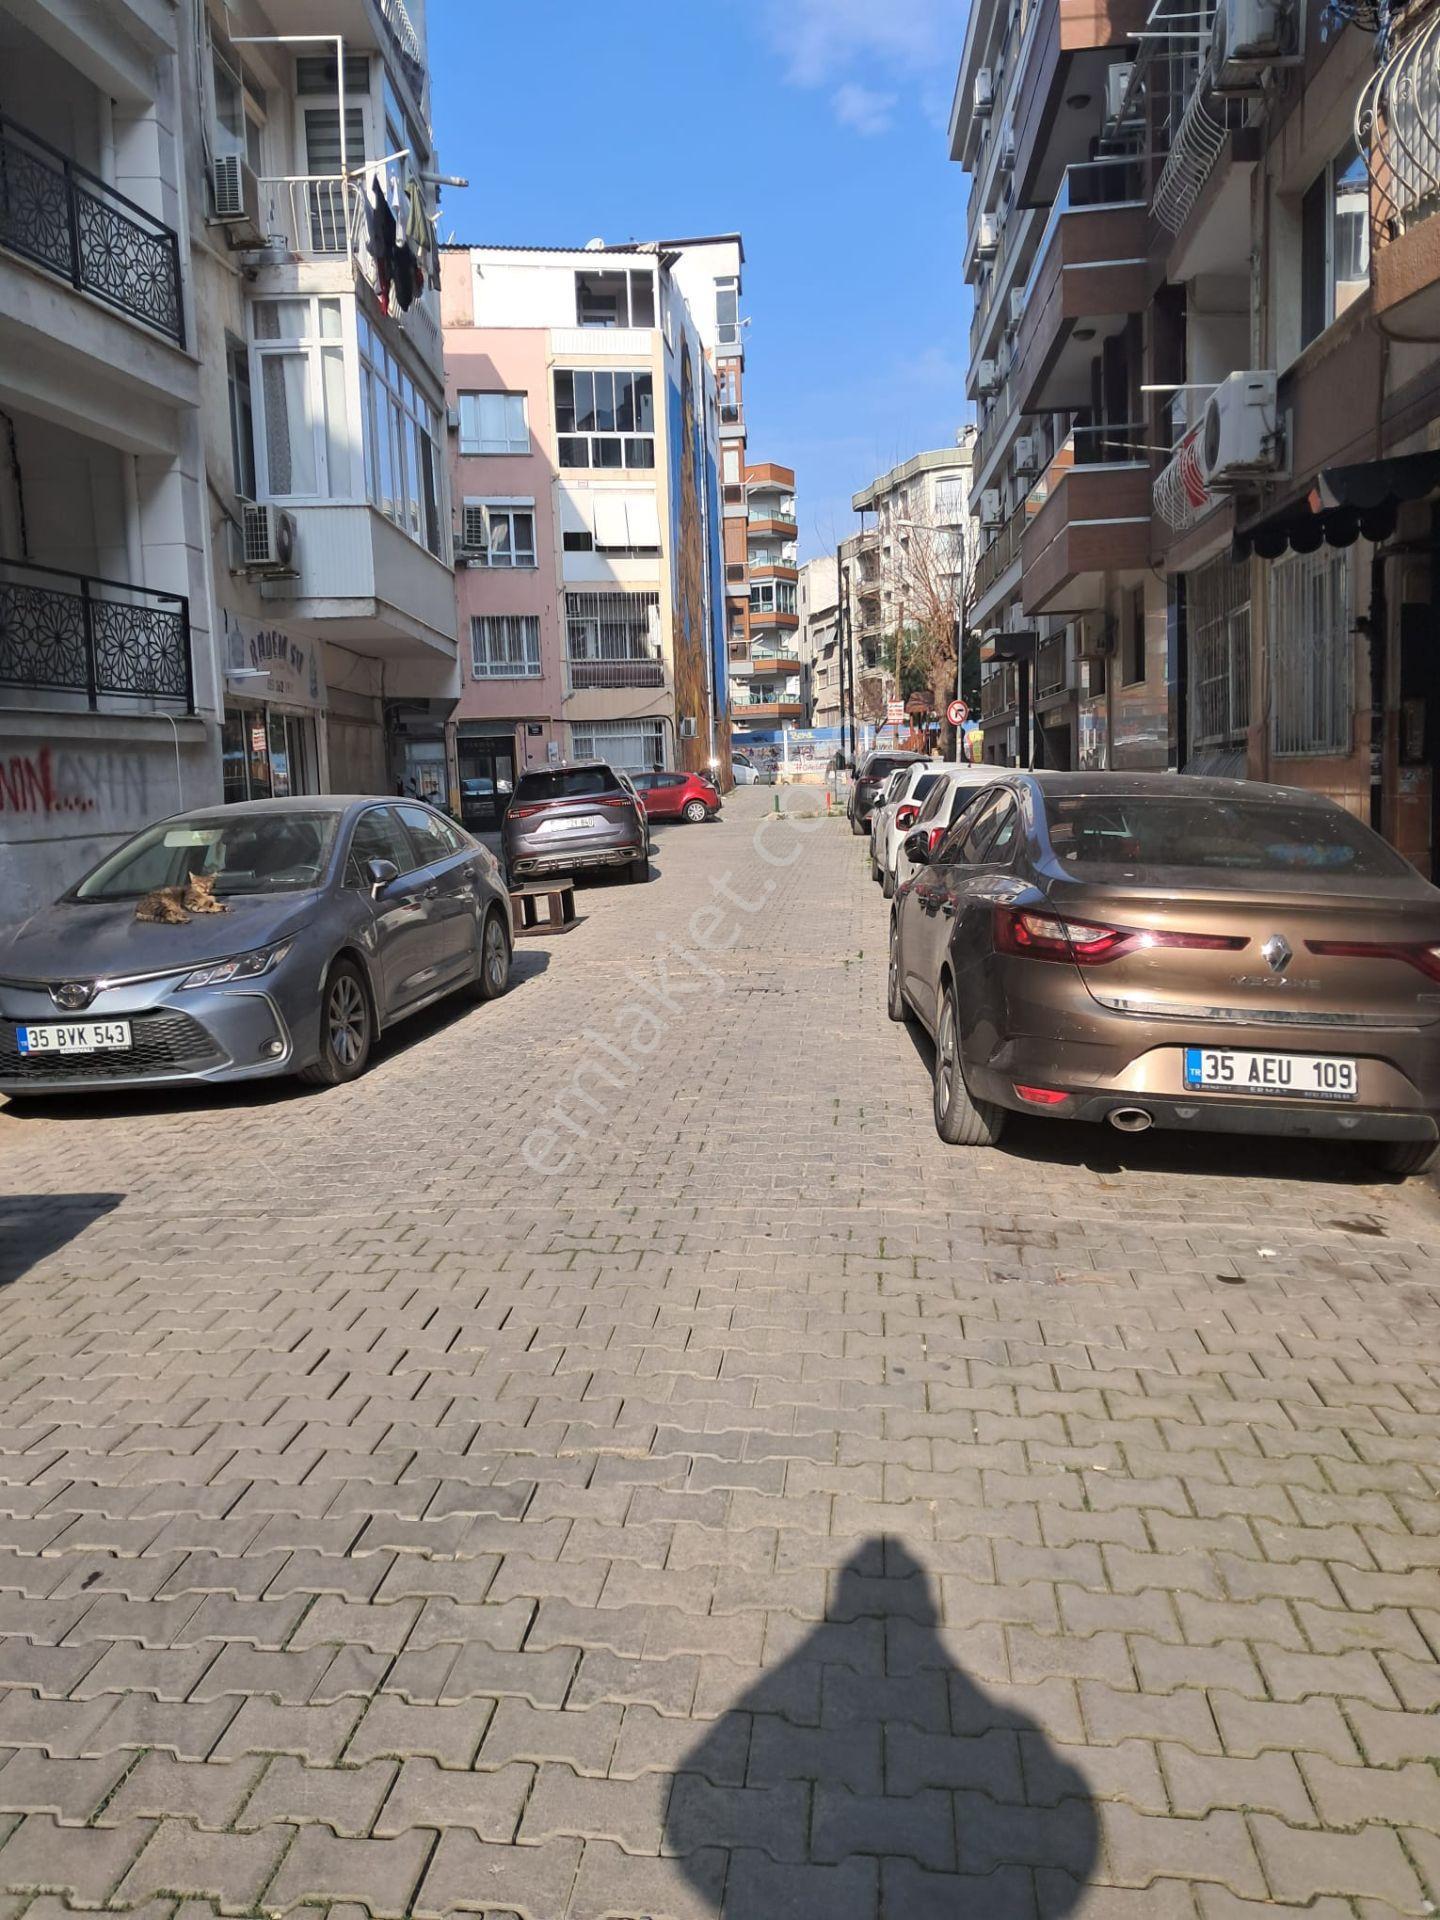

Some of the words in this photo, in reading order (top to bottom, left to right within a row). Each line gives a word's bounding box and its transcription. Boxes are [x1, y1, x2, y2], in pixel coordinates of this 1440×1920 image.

[28, 1029, 49, 1048] 35
[56, 1026, 88, 1047] BVK
[93, 1024, 125, 1044] 543
[1189, 1068, 1202, 1077] TR
[1205, 1054, 1235, 1082] 35
[1248, 1057, 1292, 1086] AEU
[1312, 1061, 1352, 1090] 109
